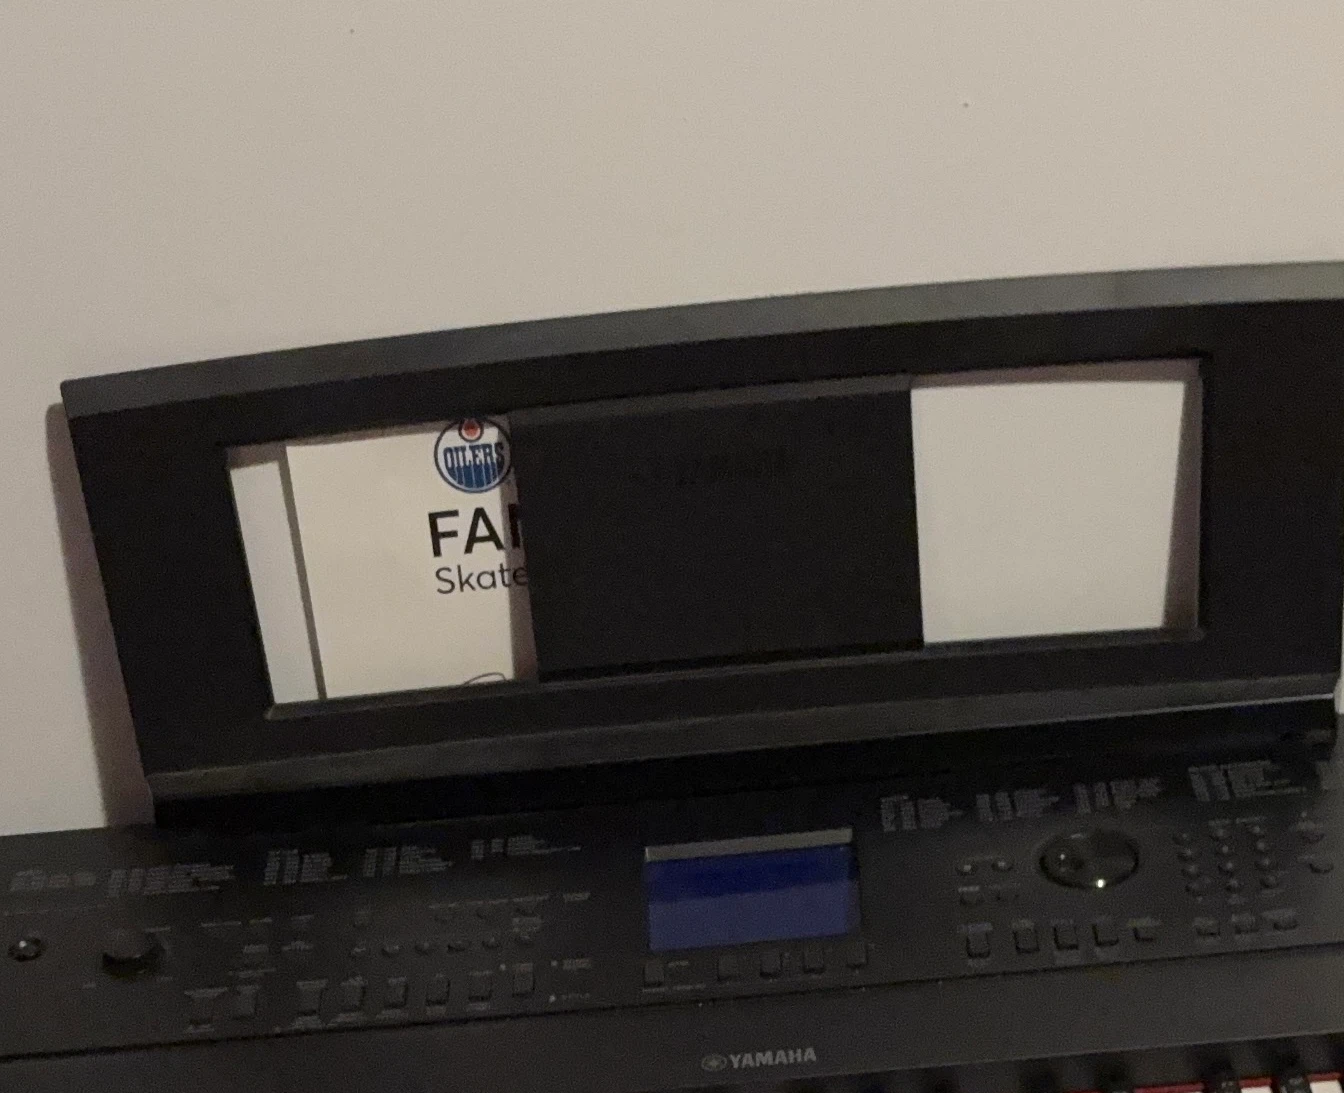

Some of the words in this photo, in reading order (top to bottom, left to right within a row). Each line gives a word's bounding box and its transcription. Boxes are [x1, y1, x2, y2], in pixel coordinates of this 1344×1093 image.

[443, 441, 505, 471] OILERS
[435, 562, 529, 594] Skate
[729, 1047, 816, 1069] YAMAHA
